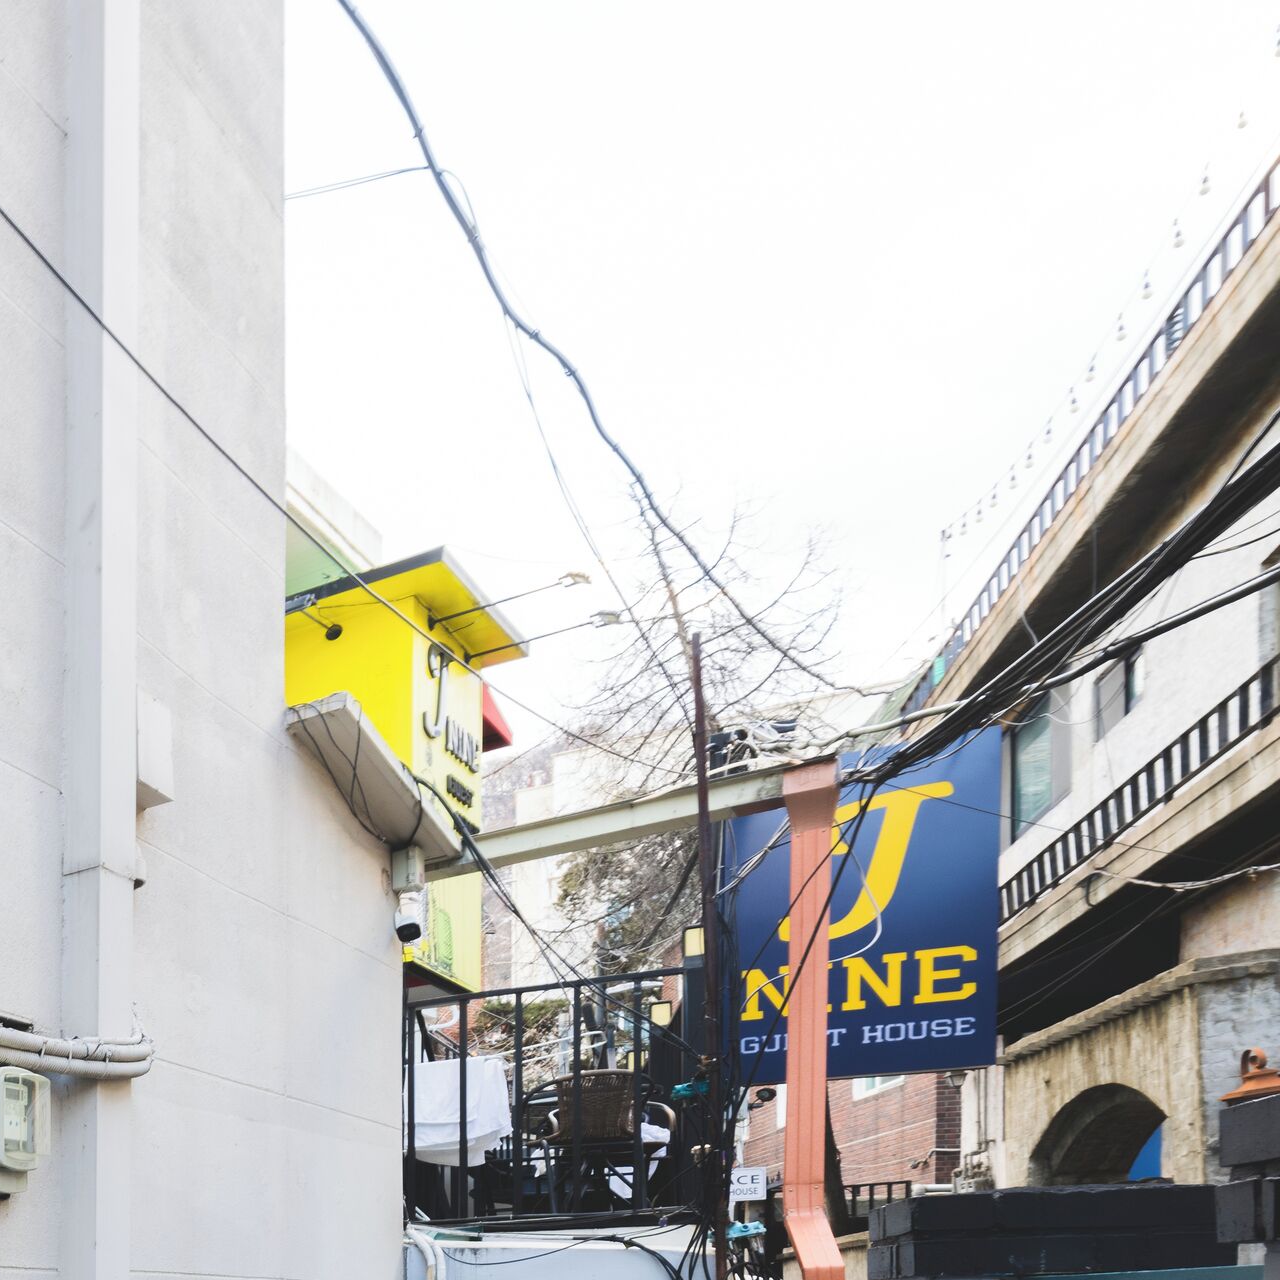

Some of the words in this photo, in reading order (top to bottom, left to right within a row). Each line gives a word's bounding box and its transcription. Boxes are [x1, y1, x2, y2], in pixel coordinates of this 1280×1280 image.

[740, 945, 977, 1021] NNE
[740, 1029, 846, 1054] GUT
[862, 1016, 976, 1044] HOUSE
[730, 1174, 760, 1185] CE
